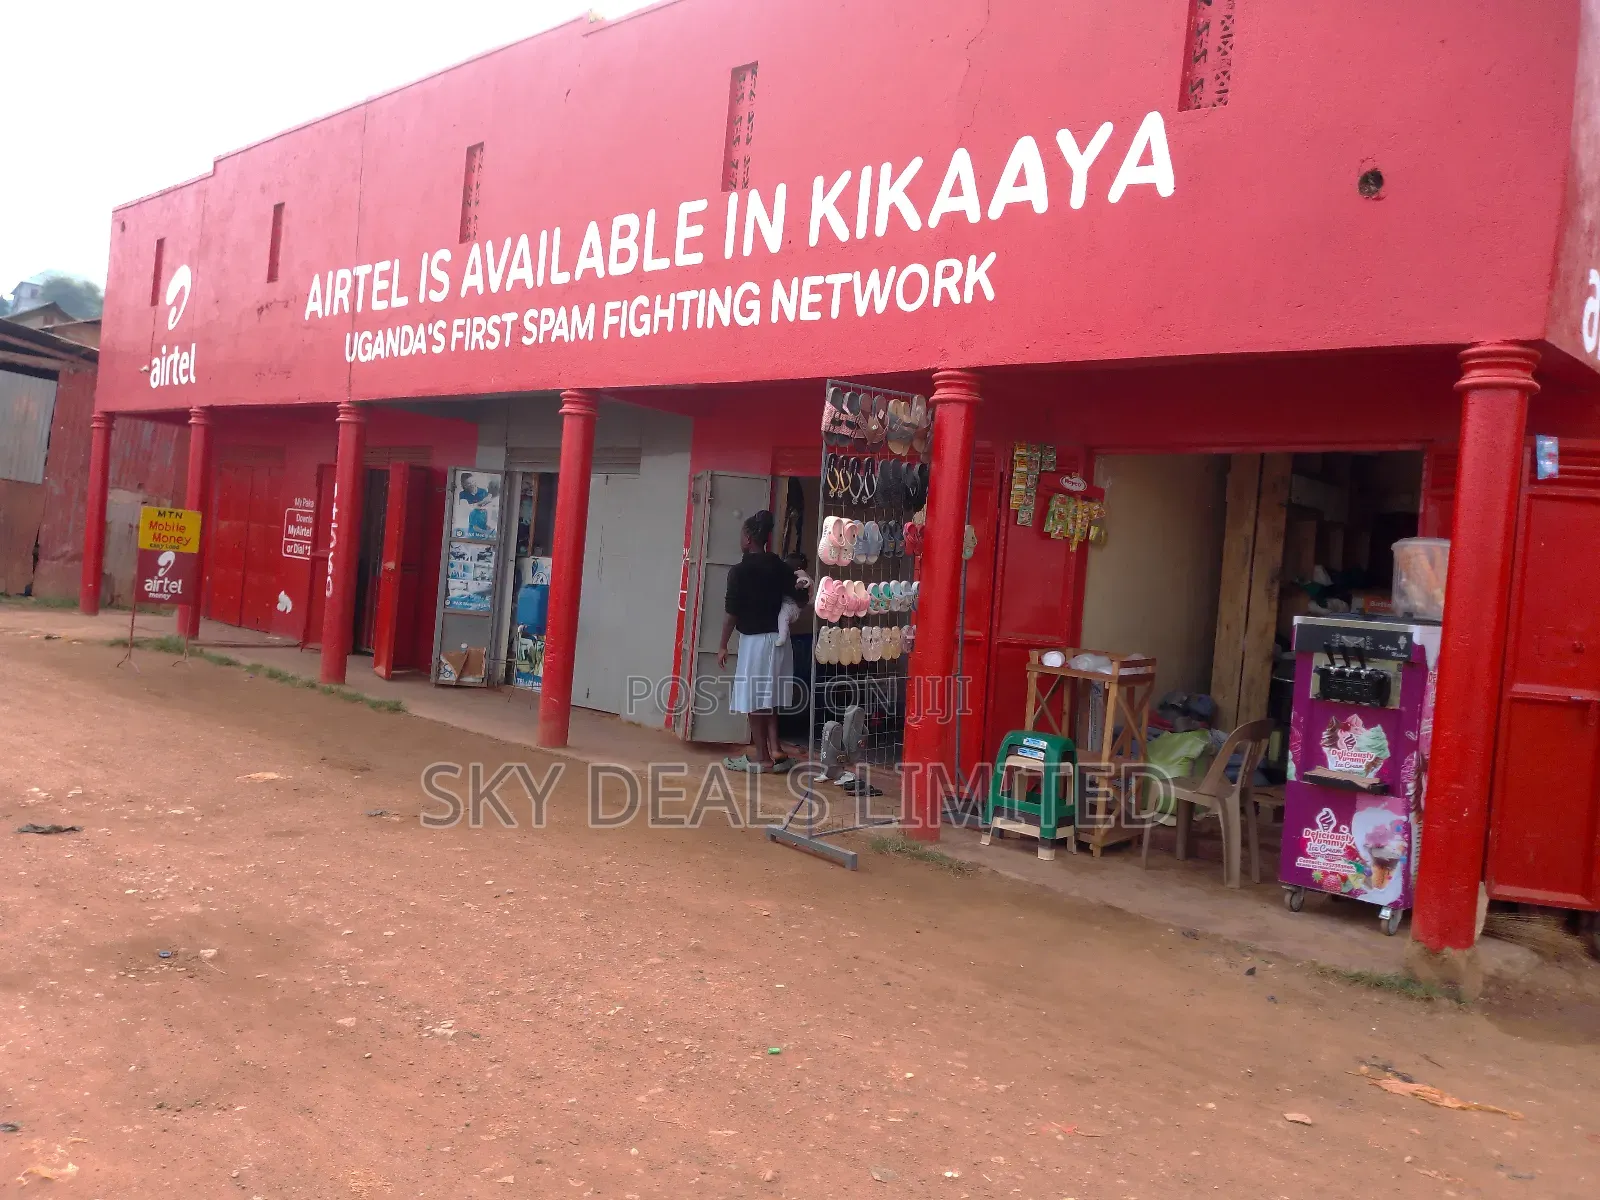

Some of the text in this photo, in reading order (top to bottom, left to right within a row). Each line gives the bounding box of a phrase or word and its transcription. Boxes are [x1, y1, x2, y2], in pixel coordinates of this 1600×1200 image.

[304, 110, 1176, 321] AIRTEL IS AVAILABLE IN KIKAAYA
[345, 251, 997, 363] UGANDA'S FIRST SPAM FIGHTING NETWORK
[149, 342, 196, 389] airtel
[157, 510, 183, 520] MTN
[149, 520, 186, 533] Mobile
[152, 533, 191, 546] Money
[293, 543, 304, 555] Dial
[144, 576, 183, 594] airtel
[1331, 749, 1374, 759] Deliciously
[1338, 755, 1367, 764] Yummy
[1304, 829, 1355, 844] Deliciously
[1312, 838, 1345, 849] Yummy
